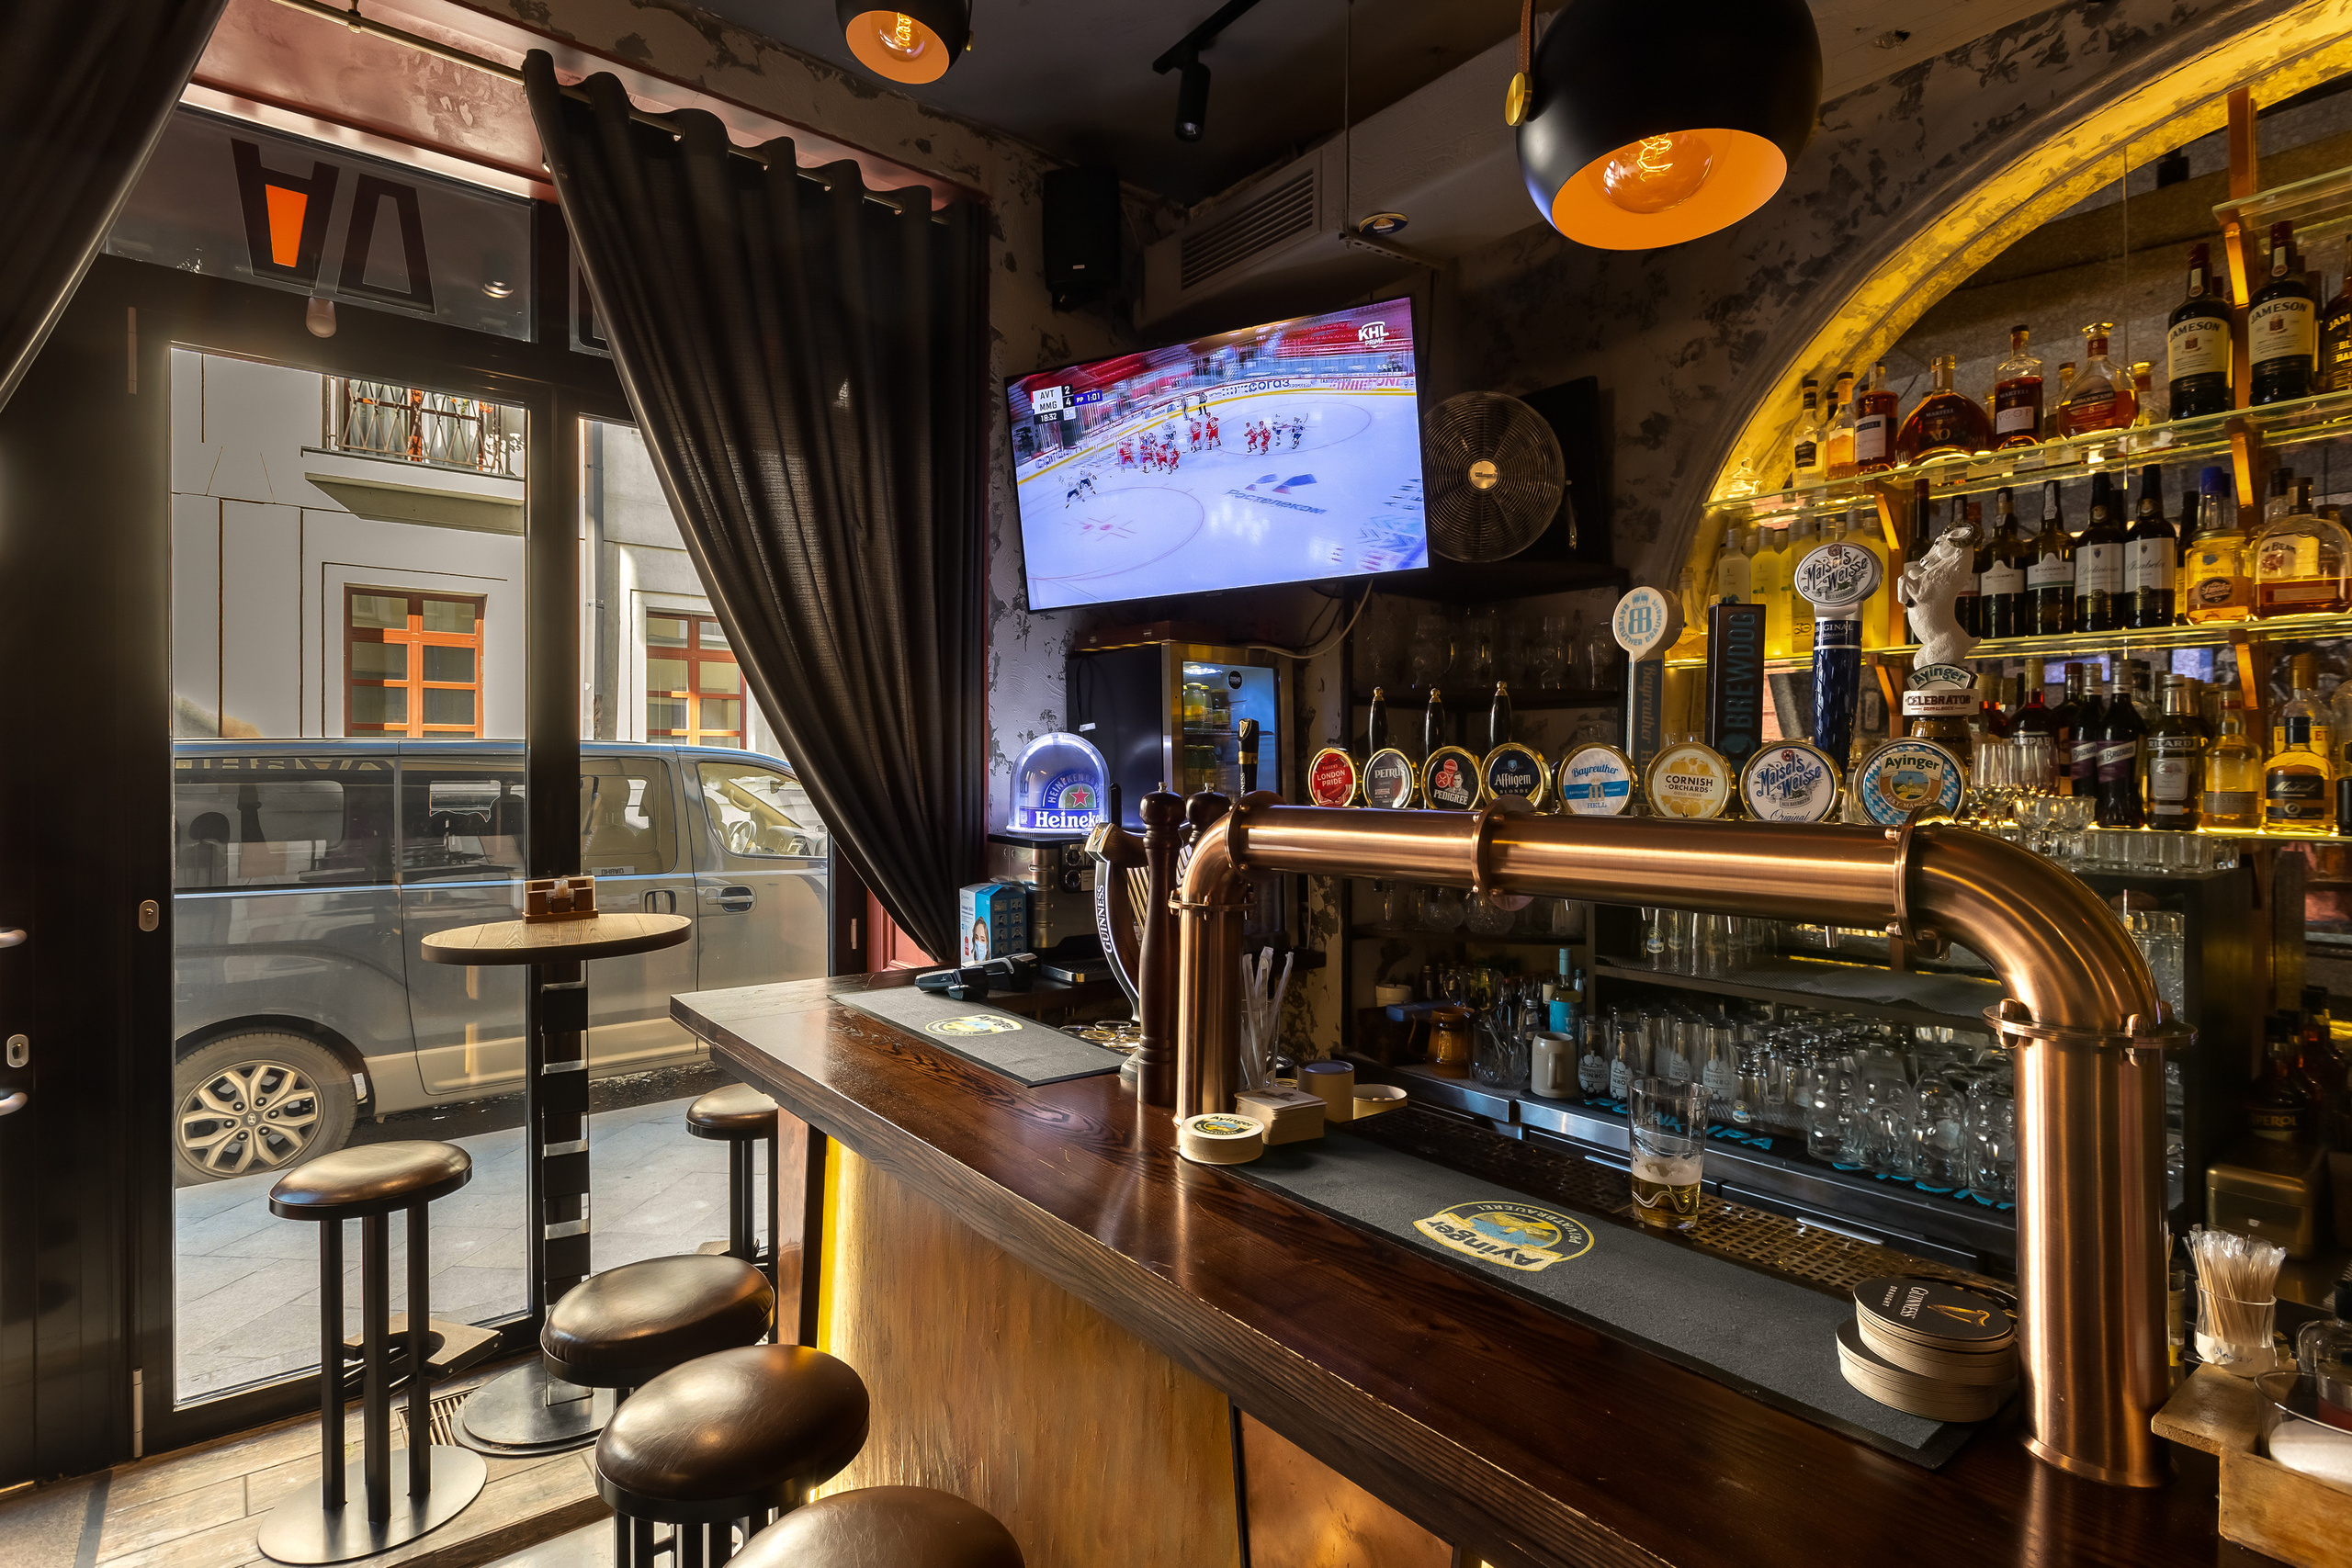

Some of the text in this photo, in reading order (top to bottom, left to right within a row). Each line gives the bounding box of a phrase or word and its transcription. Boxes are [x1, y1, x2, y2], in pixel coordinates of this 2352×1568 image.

[2252, 301, 2308, 324] JAMESON
[1358, 325, 1389, 341] KHL
[2169, 321, 2220, 343] JAMESON
[1365, 337, 1385, 345] PRIME
[1040, 389, 1055, 400] AVT
[1064, 386, 1069, 394] 2
[1087, 392, 1100, 401] 1:01
[1039, 401, 1057, 412] MMG
[1065, 398, 1071, 406] 4
[1040, 413, 1057, 422] 18:32
[1929, 428, 1951, 443] XO
[1823, 557, 1868, 591] Weisse
[1619, 604, 1643, 646] BAYREUTHER
[1724, 613, 1756, 728] BREWDOG
[1912, 667, 1966, 684] Ayinger
[1907, 695, 1971, 705] CELEBRATOR
[2148, 739, 2192, 748] RICARD
[1884, 754, 1939, 770] Ayinger
[1317, 770, 1345, 781] LONDON
[1374, 767, 1406, 779] PETRUS
[1571, 764, 1618, 777] Bayreuther
[1321, 777, 1342, 787] PRIDE
[1494, 773, 1532, 788] Affligem
[1666, 774, 1713, 786] CORNISH
[1776, 765, 1821, 797] Weisse
[1434, 789, 1468, 806] PEDIGREE
[1096, 885, 1114, 953] GUINNESS
[1478, 1204, 1583, 1245] PRIVATBRAUEREI
[1426, 1220, 1544, 1267] Ayinger
[1900, 1286, 1928, 1319] GUINNESS
